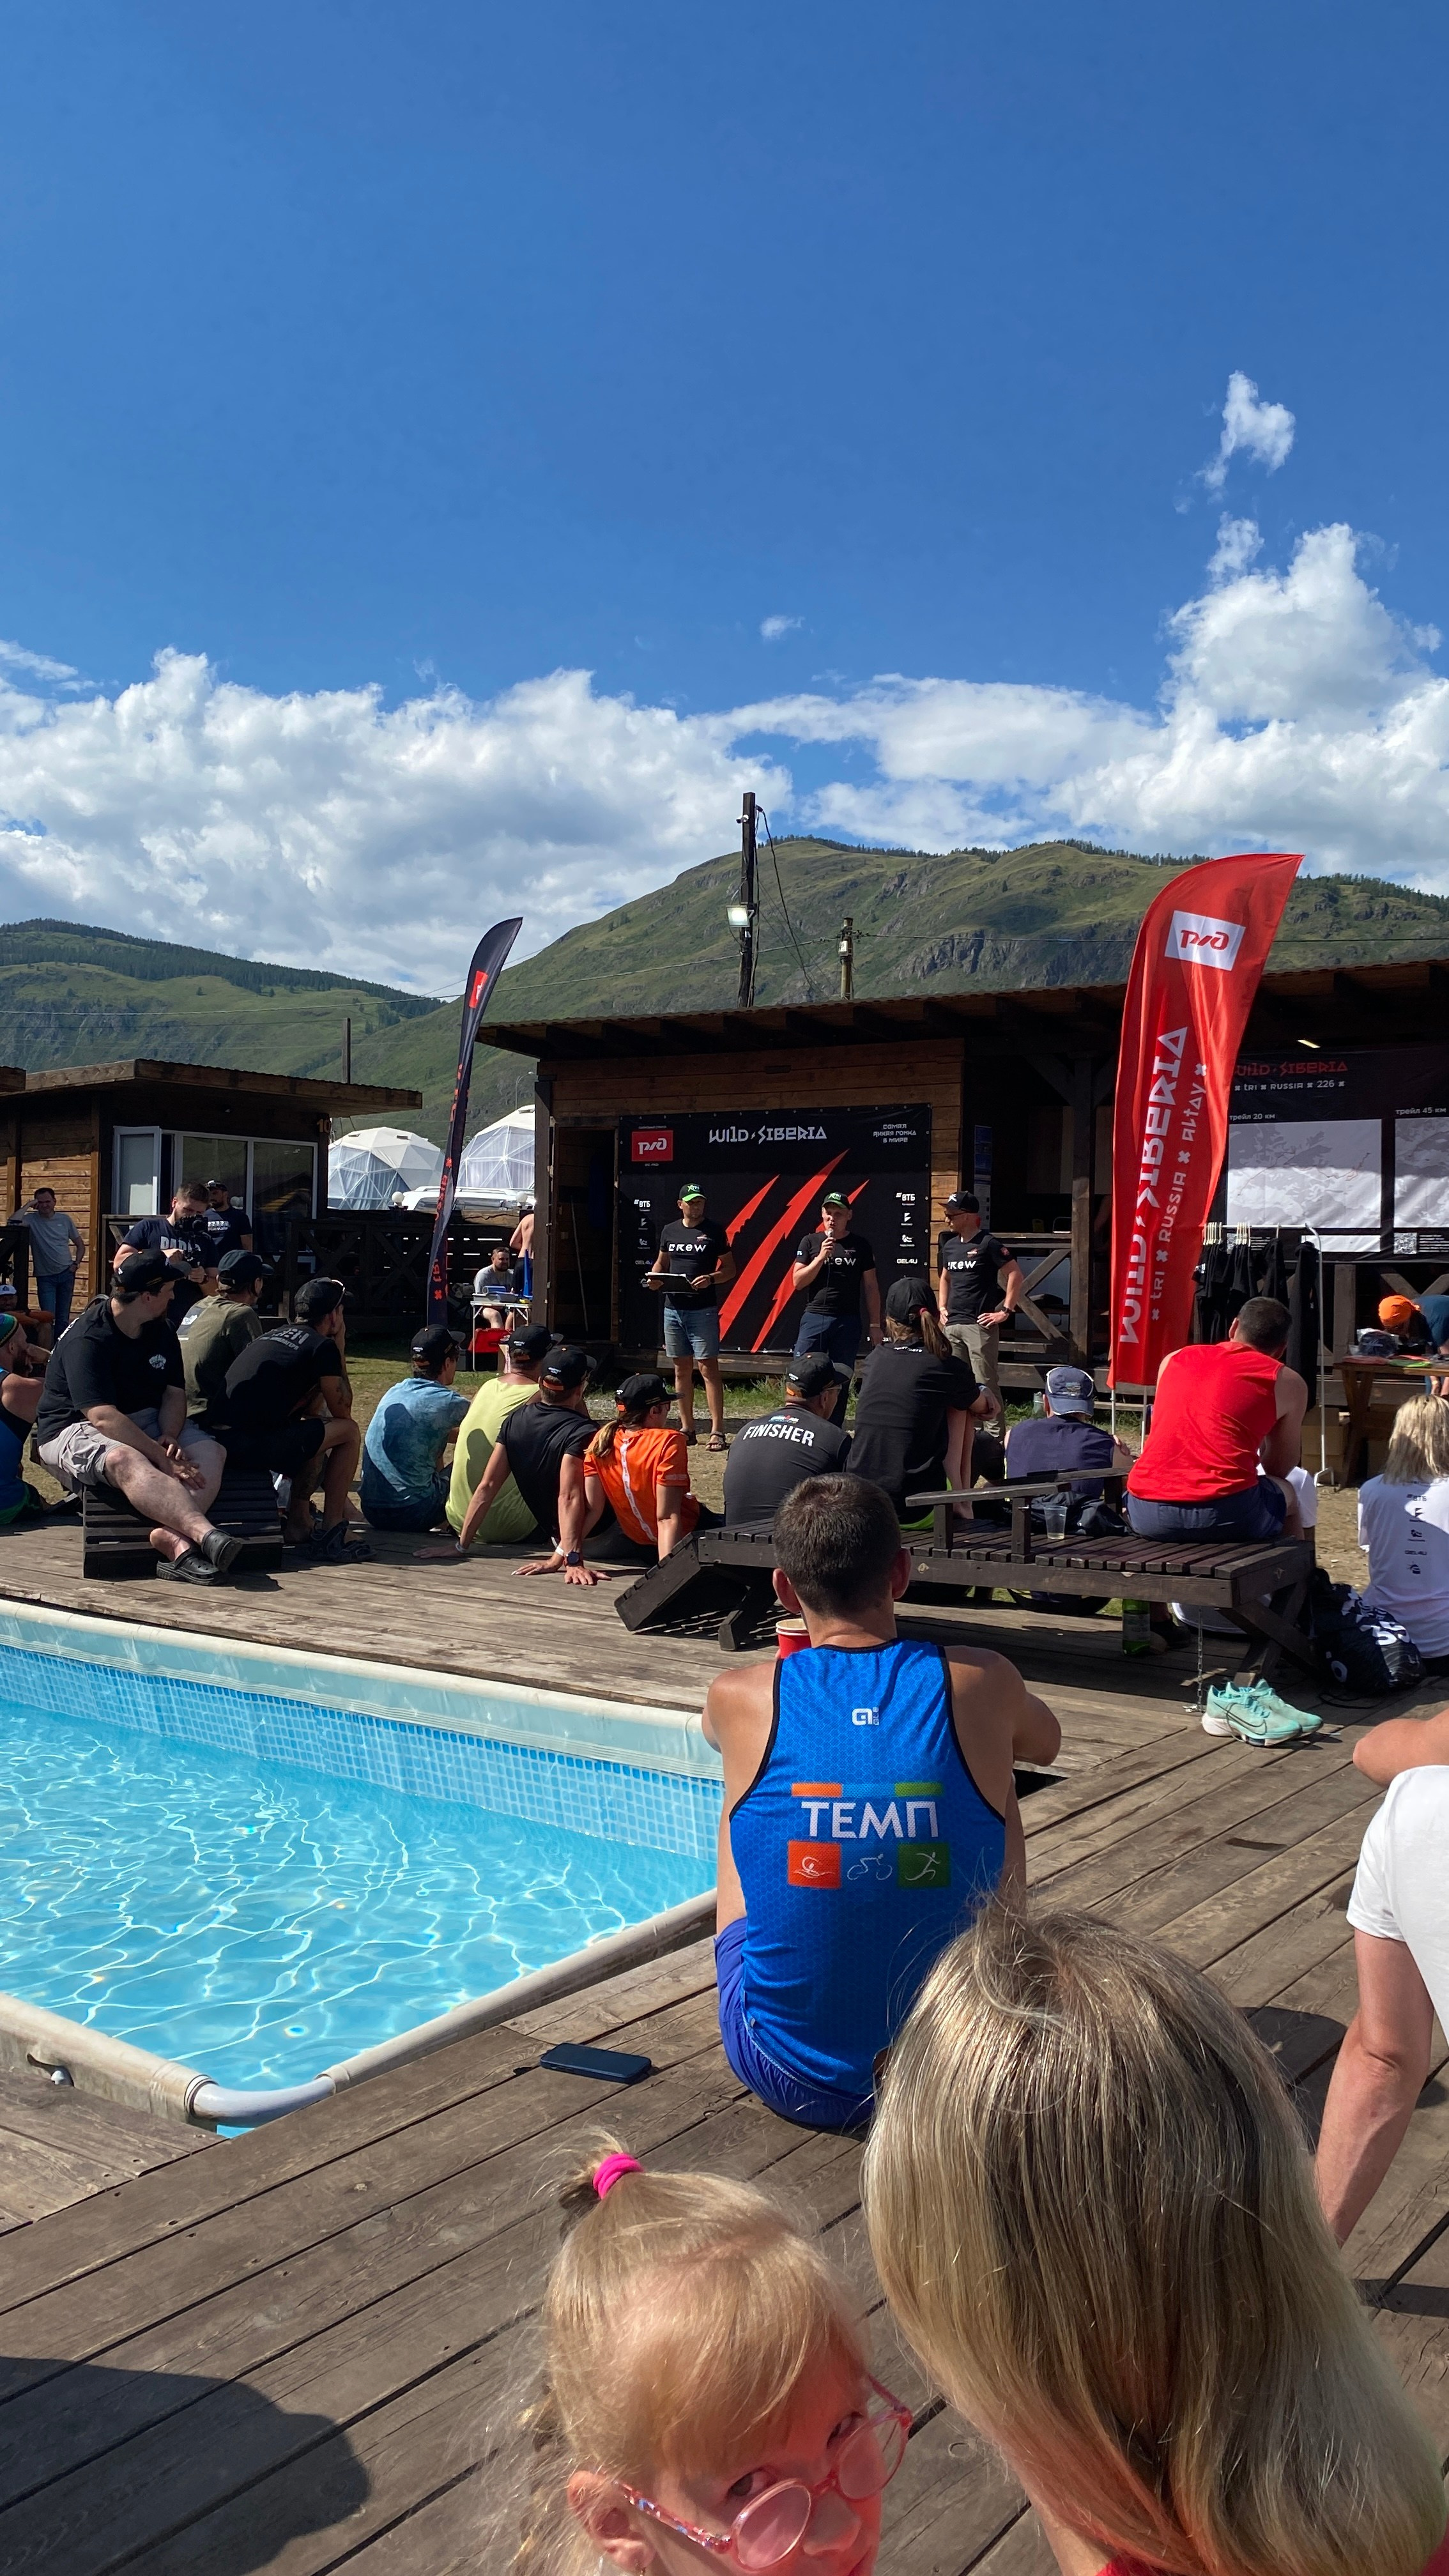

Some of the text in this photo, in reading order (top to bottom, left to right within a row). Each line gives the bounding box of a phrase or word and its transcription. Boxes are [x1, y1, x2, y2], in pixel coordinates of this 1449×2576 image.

[1279, 1061, 1348, 1077] SIBERIA
[1136, 1026, 1188, 1208] SIBERIA
[1395, 1107, 1420, 1116] трейл
[758, 1125, 827, 1144] SIBERIA
[1158, 1172, 1186, 1243] RUSSIA
[742, 1423, 815, 1447] FINISHER
[801, 1800, 939, 1839] ТЕМП
